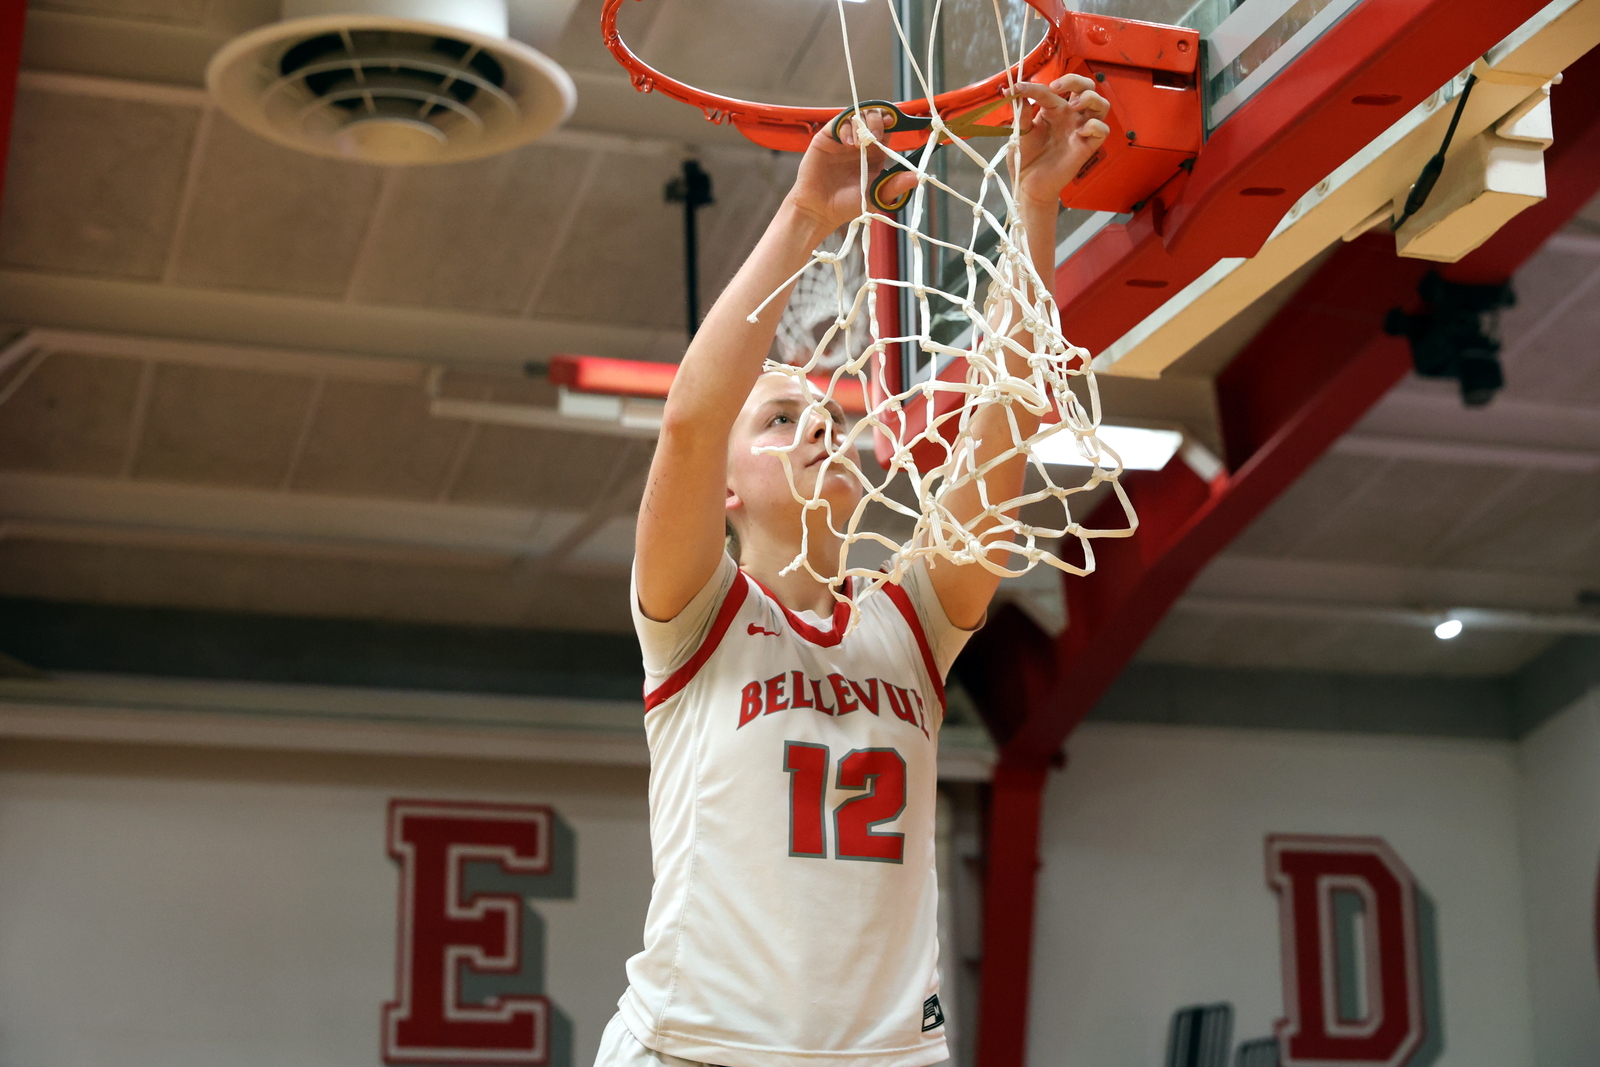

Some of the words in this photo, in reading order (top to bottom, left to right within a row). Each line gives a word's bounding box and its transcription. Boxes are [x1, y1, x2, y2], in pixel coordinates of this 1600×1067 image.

[783, 740, 907, 865] 12
[381, 797, 554, 1066] E
[1264, 832, 1428, 1067] D
